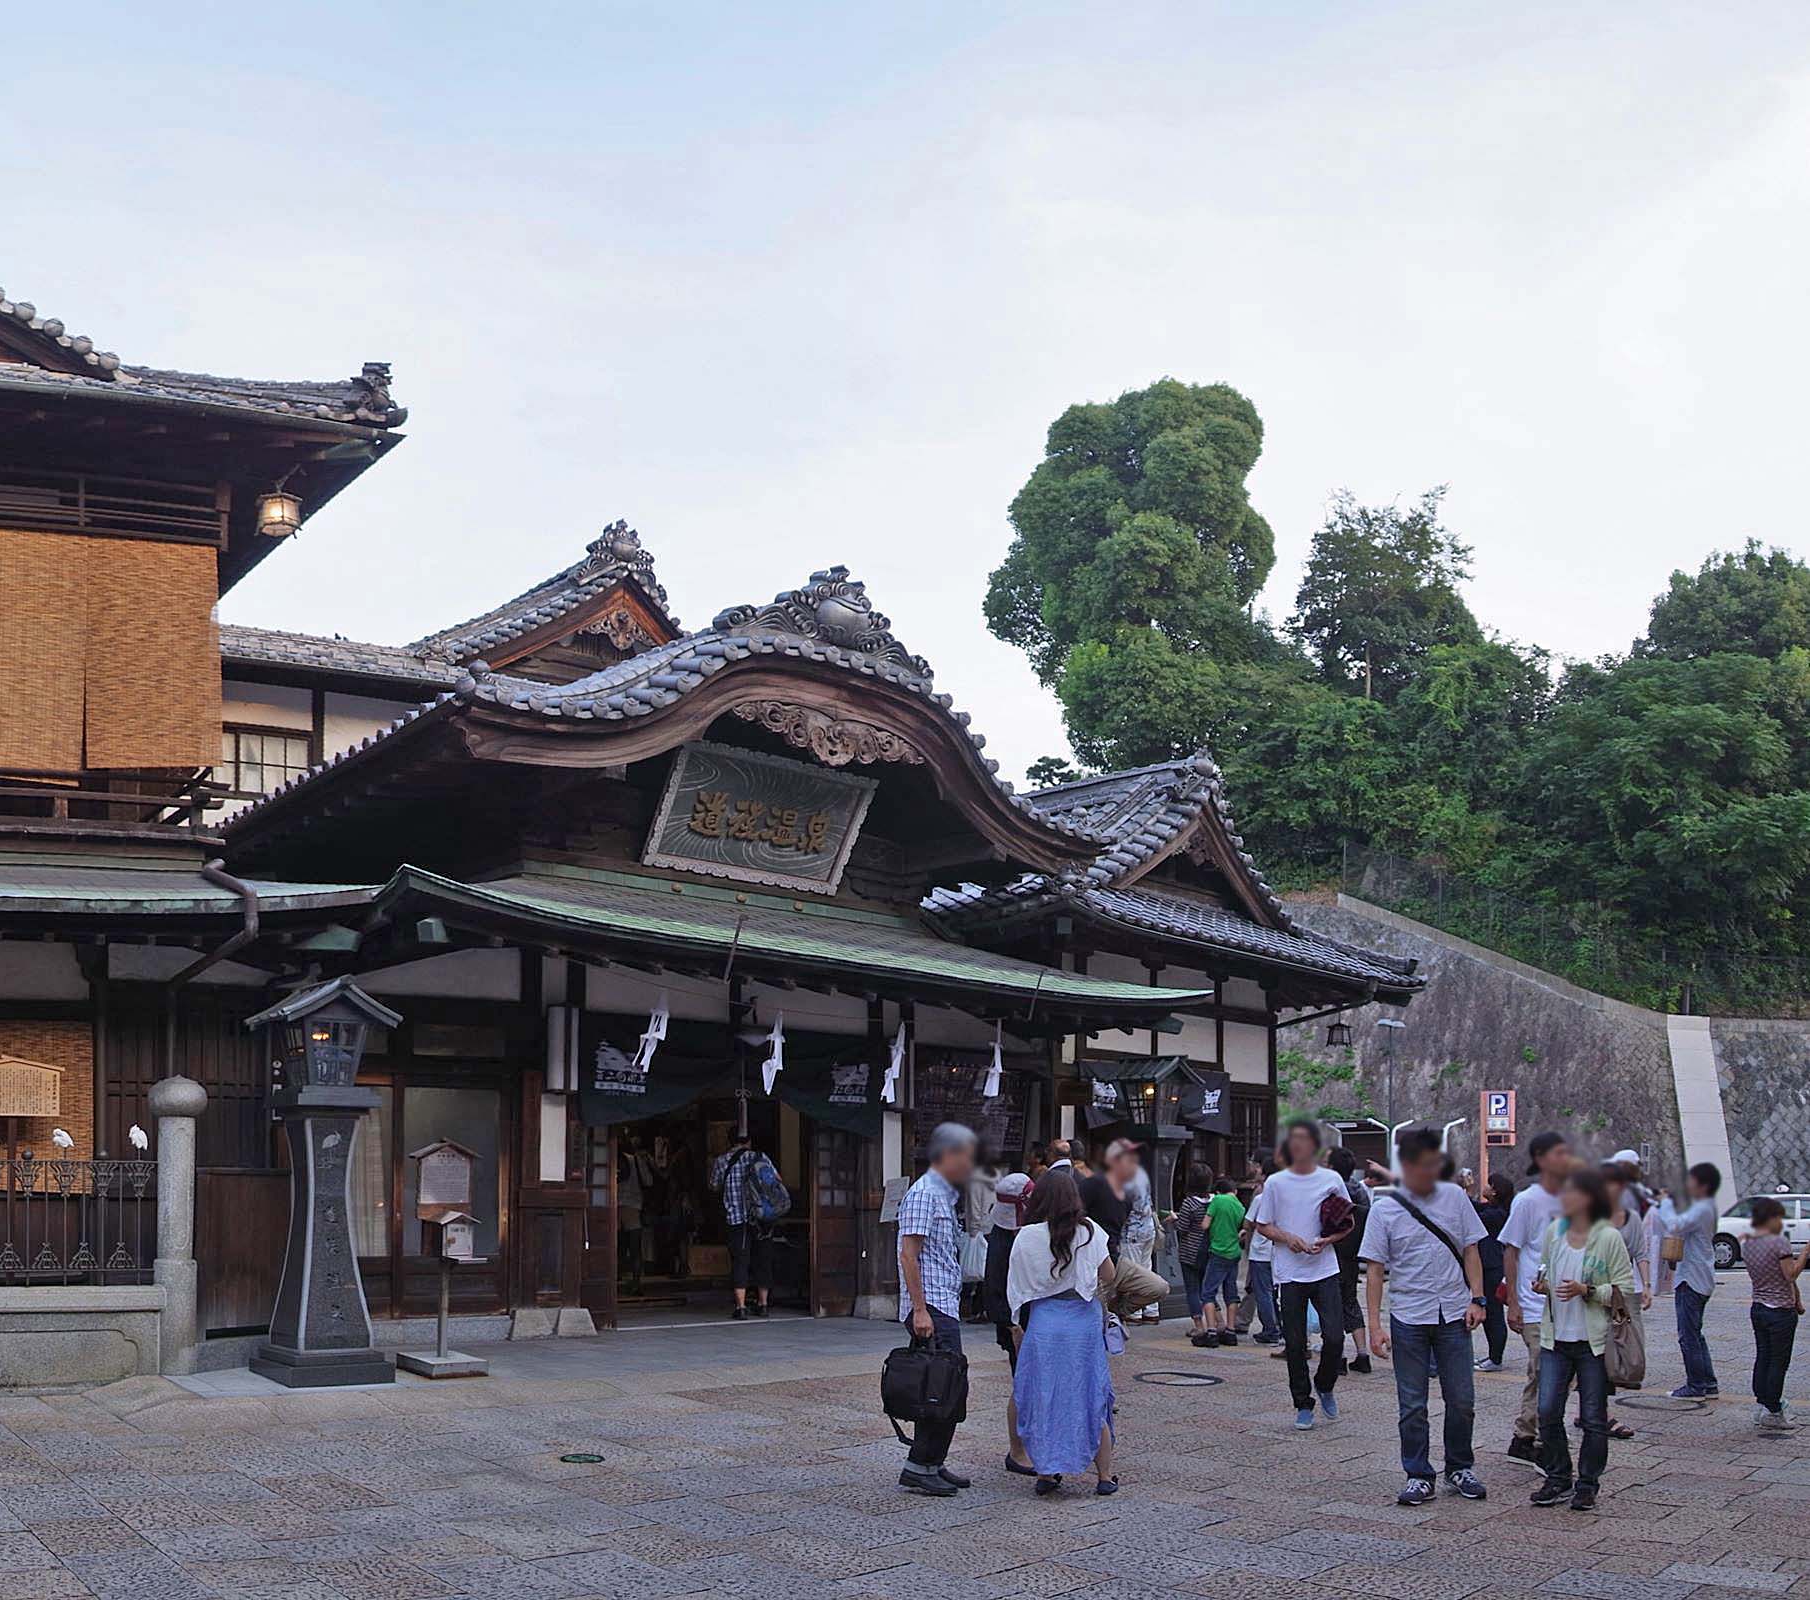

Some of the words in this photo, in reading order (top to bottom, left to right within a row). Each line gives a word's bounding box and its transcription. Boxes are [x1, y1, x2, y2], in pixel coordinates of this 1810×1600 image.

[687, 790, 831, 854] 道後温泉
[1491, 1094, 1506, 1115] P
